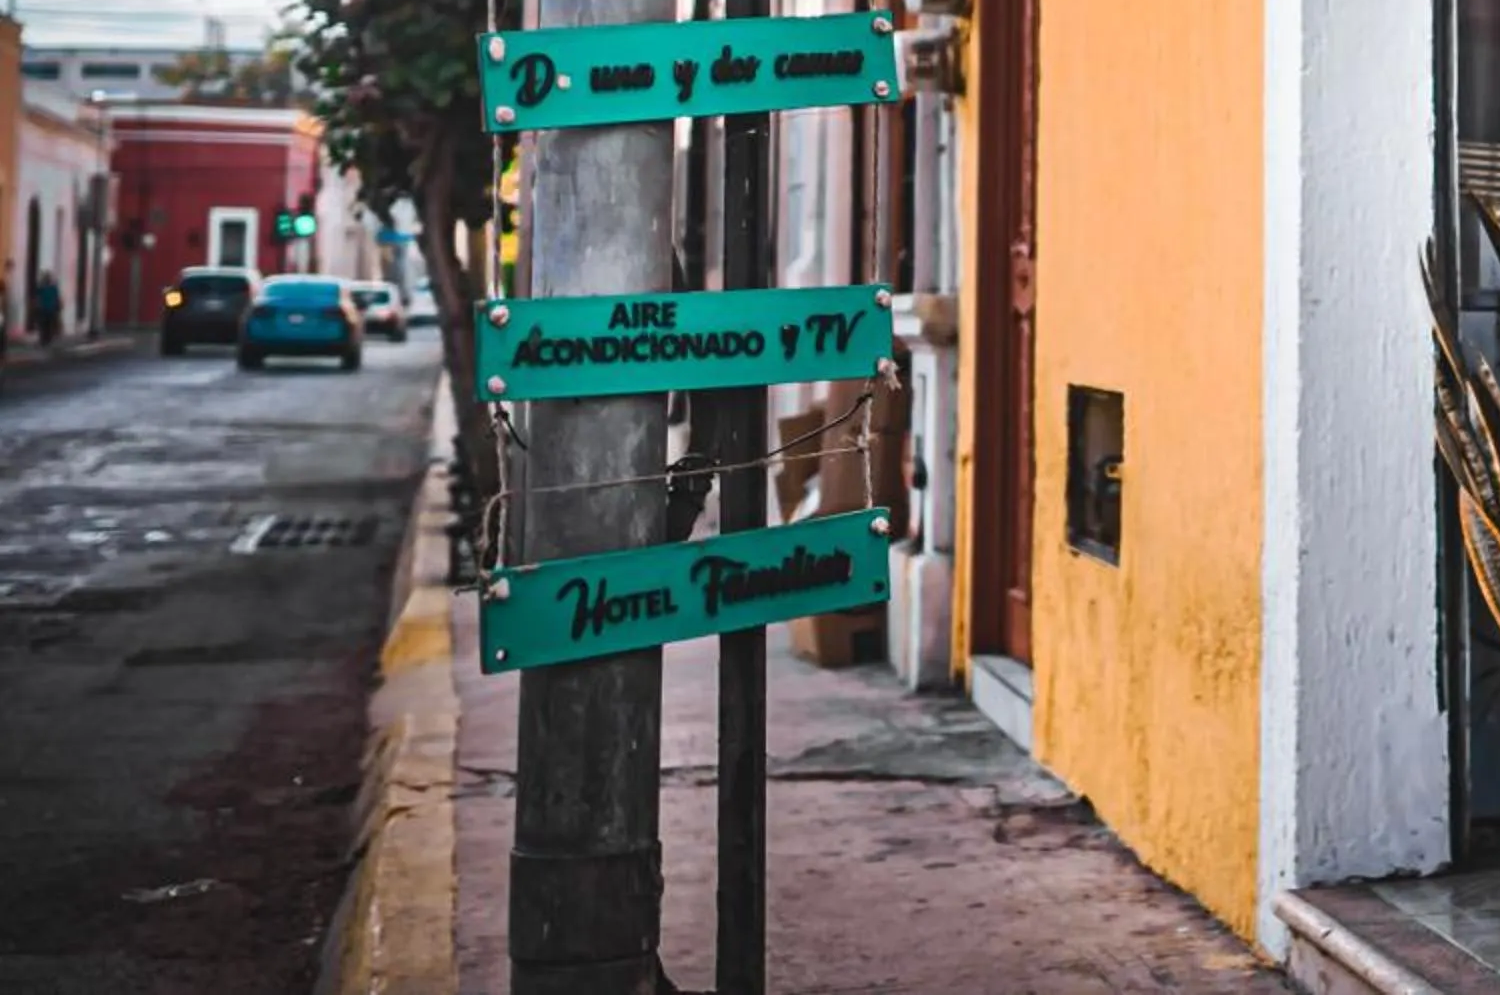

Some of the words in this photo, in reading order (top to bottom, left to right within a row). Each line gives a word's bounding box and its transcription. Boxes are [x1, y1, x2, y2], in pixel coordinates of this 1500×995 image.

[673, 60, 698, 103] y
[608, 302, 678, 330] AIRE
[805, 310, 867, 354] TV
